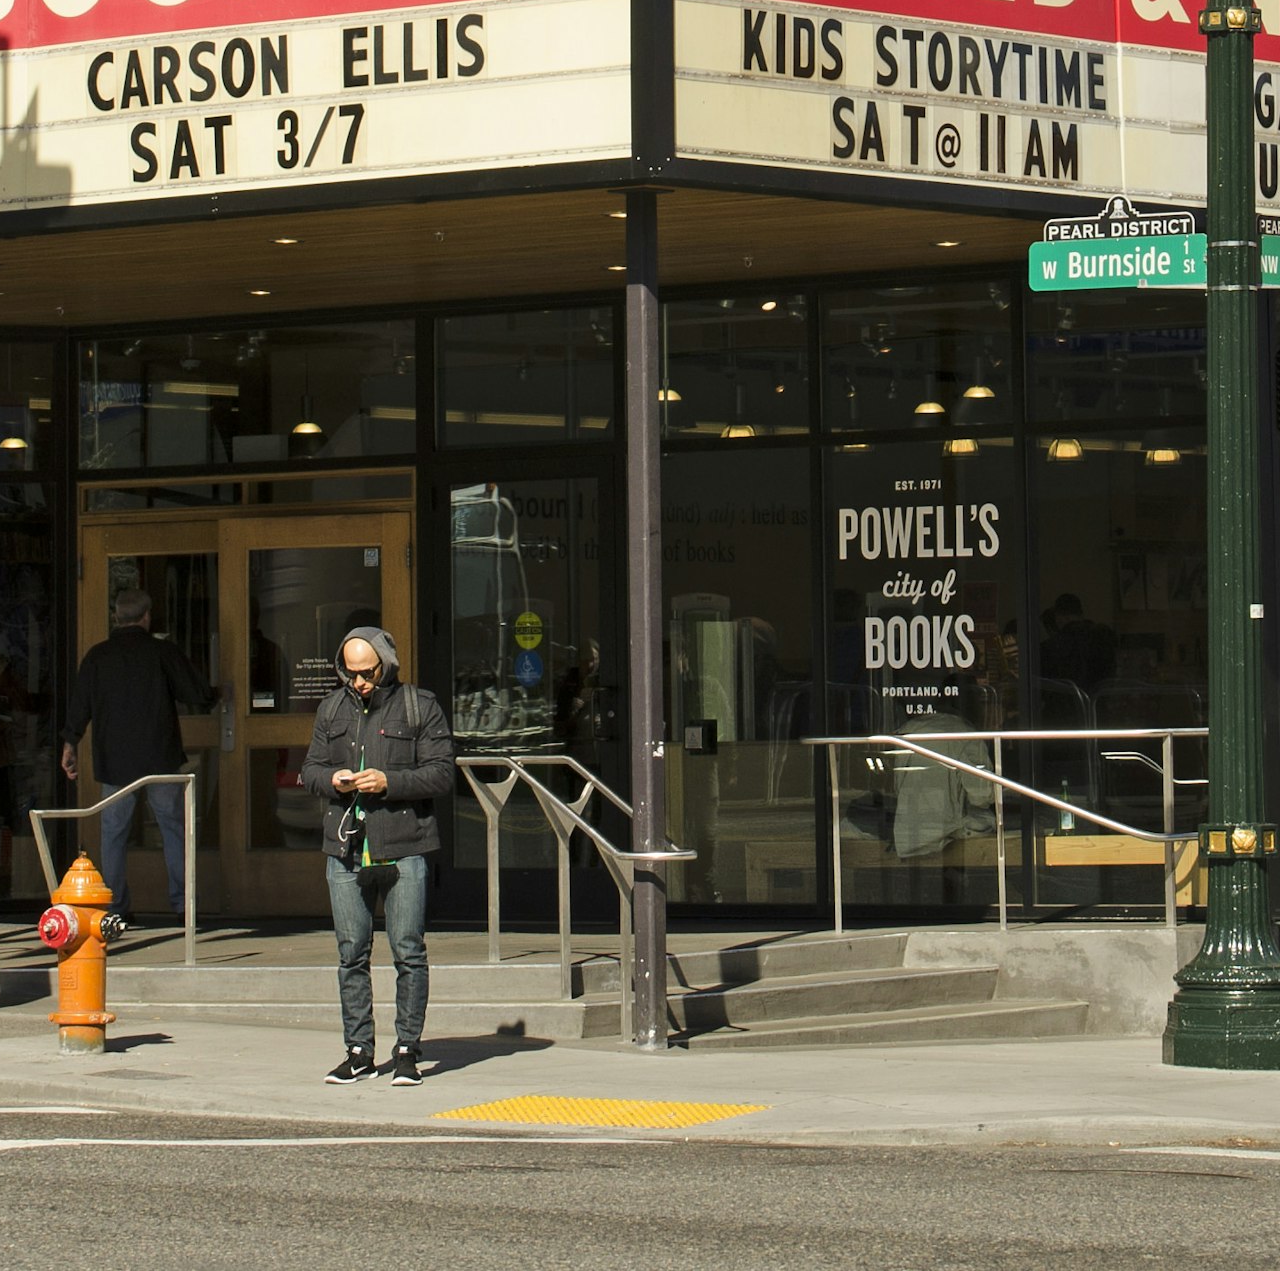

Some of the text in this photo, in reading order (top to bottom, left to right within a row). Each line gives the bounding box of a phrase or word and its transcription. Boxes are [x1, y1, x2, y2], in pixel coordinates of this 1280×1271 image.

[87, 14, 486, 111] CARSON ELLIS
[744, 9, 1108, 111] KIDS STORYTIME
[131, 104, 365, 183] SAT 3/7
[1048, 217, 1191, 241] PEARL DISTRICT
[1042, 246, 1196, 279] W Burnside St
[1261, 255, 1279, 274] NW
[895, 479, 942, 491] EST. 1971
[838, 502, 1000, 560] POWELL'S
[686, 538, 736, 563] books
[882, 569, 957, 605] city of
[864, 614, 976, 670] BOOKS
[882, 686, 959, 698] PORTLAND, OR
[906, 704, 937, 715] U.S.A.
